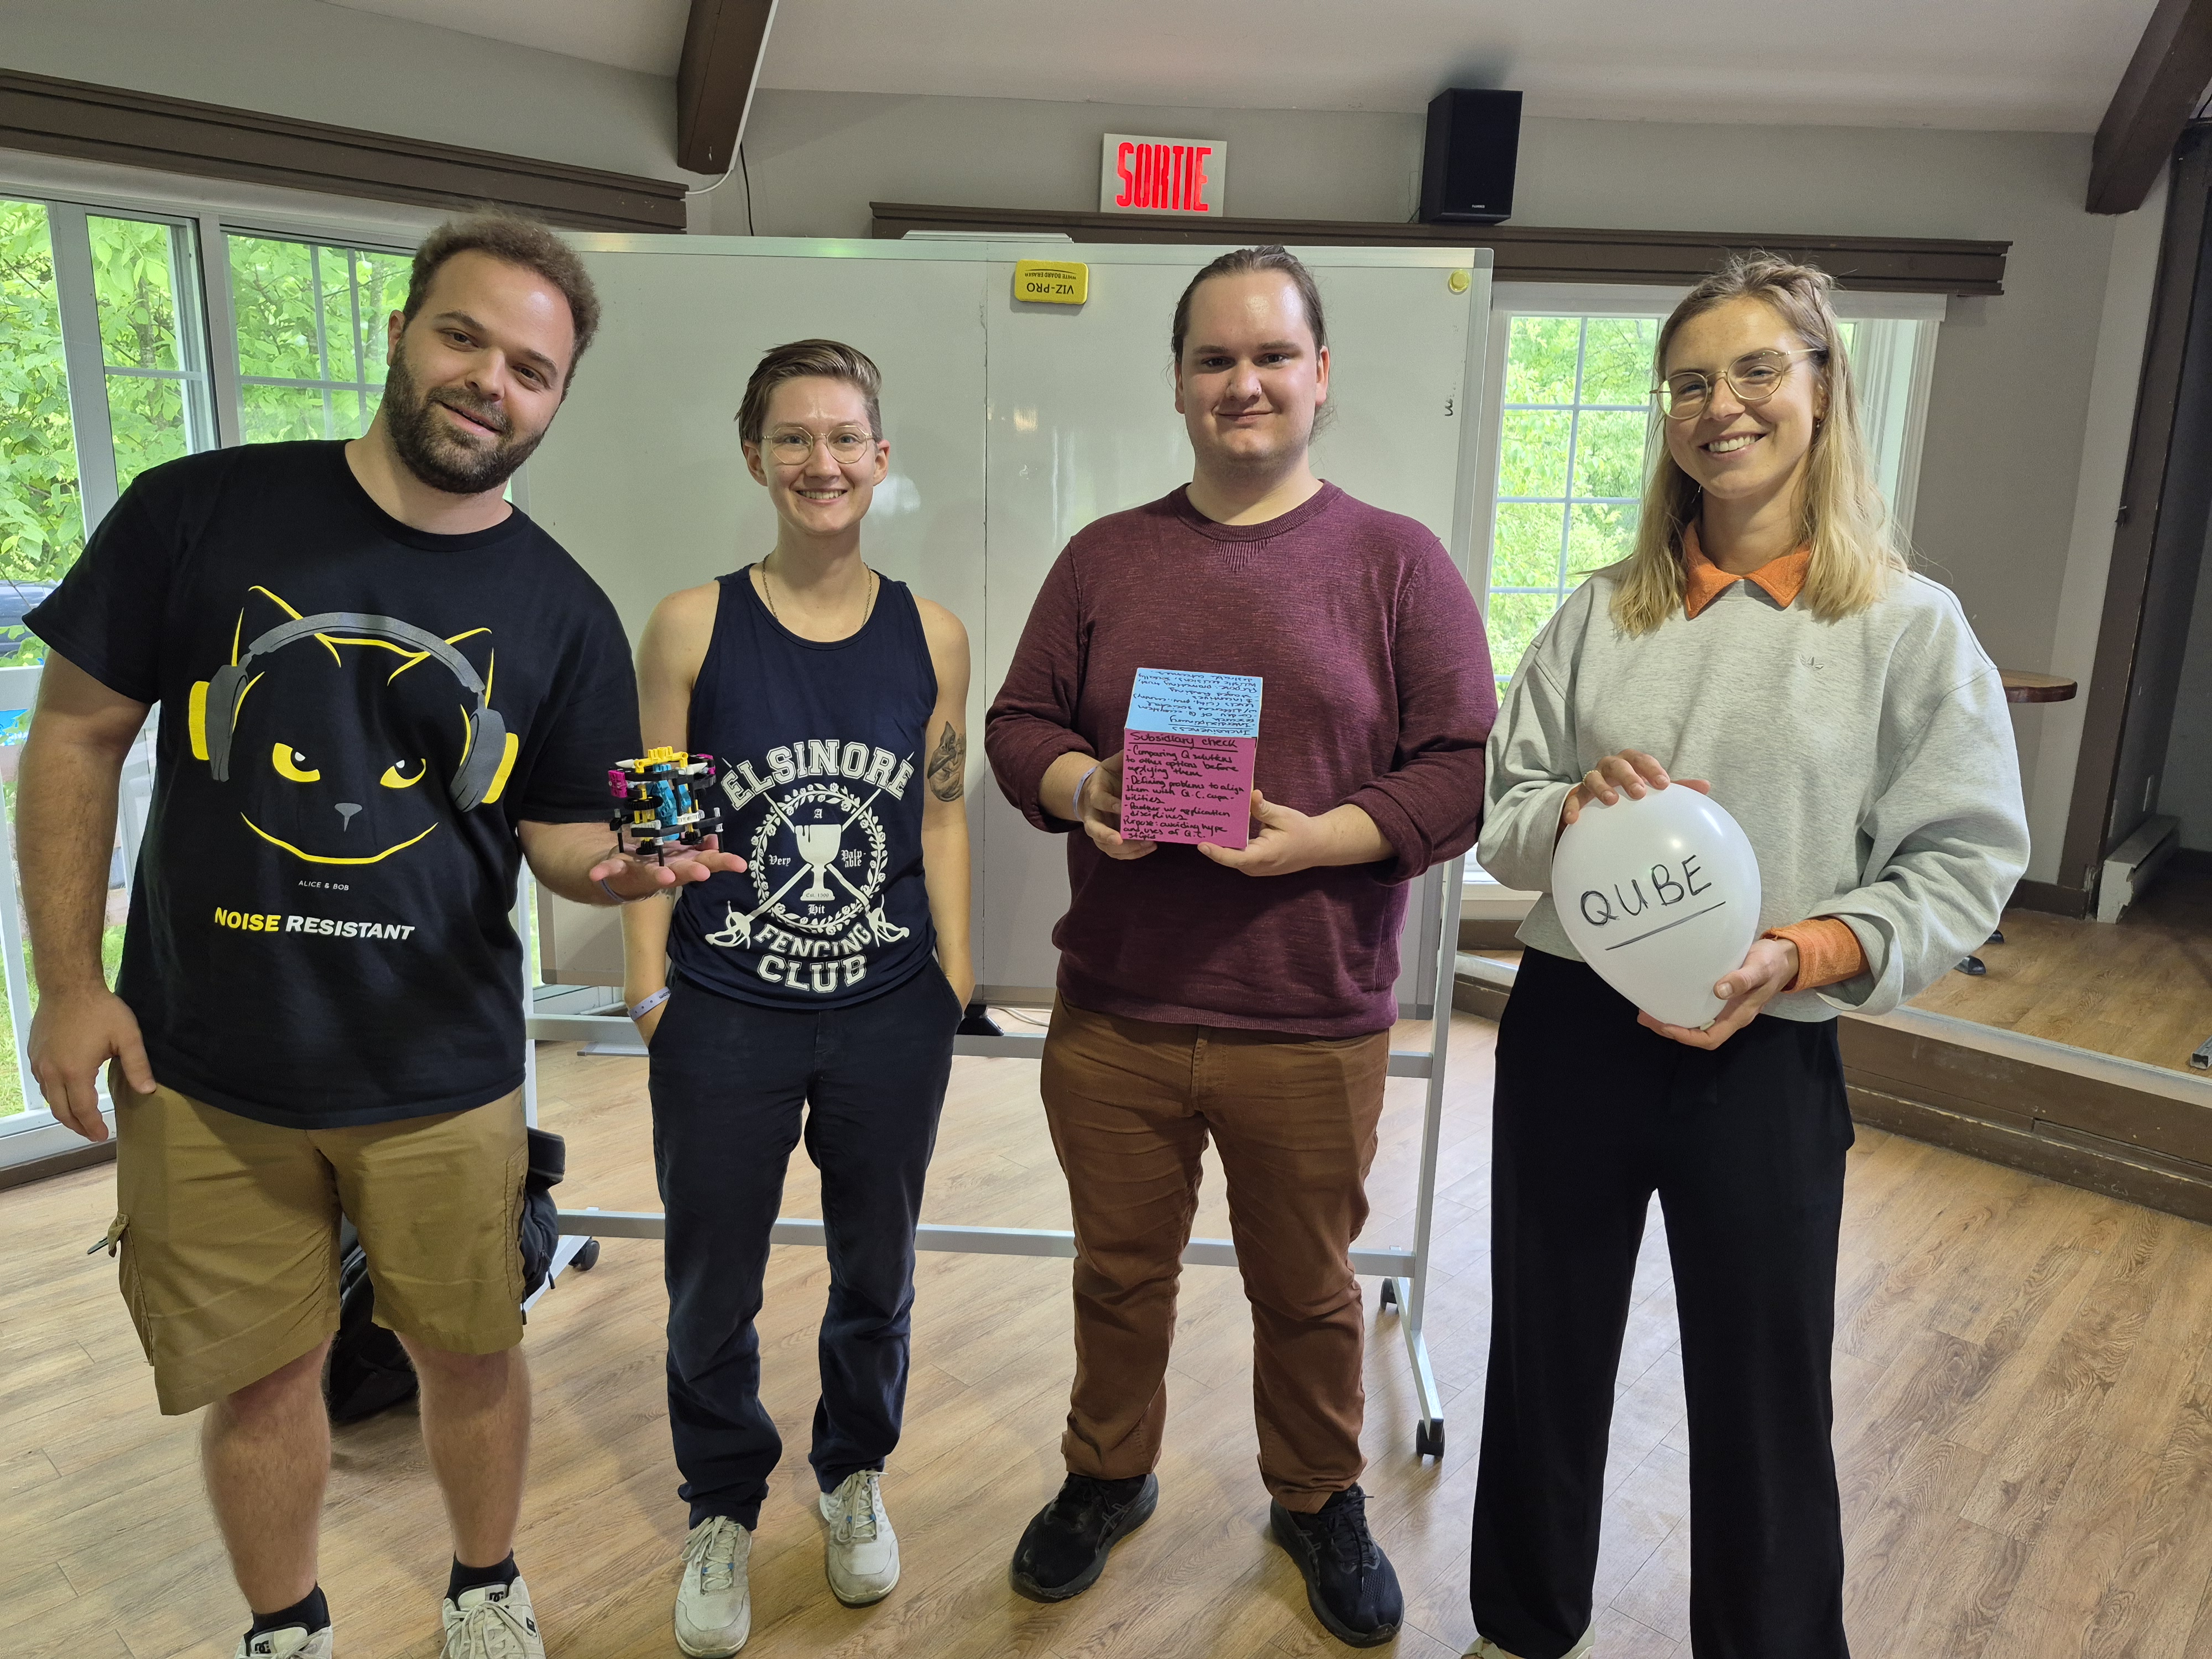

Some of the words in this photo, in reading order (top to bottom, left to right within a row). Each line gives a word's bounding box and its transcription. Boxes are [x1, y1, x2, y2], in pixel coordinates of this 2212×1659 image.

[1115, 142, 1212, 211] SORTIE
[1026, 283, 1074, 294] VIZ-PRO
[1130, 732, 1194, 749] Subsidiary
[1202, 738, 1238, 748] check
[1133, 744, 1177, 761] Comparing
[1181, 750, 1190, 759] Q
[1128, 765, 1168, 779] applying
[1173, 768, 1203, 777] them
[1166, 760, 1197, 769] options
[1203, 761, 1239, 772] before
[721, 739, 915, 811] ELSINORE
[1131, 775, 1166, 788] Defining
[1169, 780, 1205, 790] problems
[1220, 783, 1244, 795] align
[1125, 793, 1165, 804] bilities
[813, 808, 823, 819] A
[1130, 810, 1187, 820] disciplines
[1180, 806, 1230, 817] application
[1160, 821, 1199, 832] avoiding
[1202, 823, 1228, 837] hype
[769, 854, 791, 867] Very
[844, 857, 862, 868] able
[298, 880, 321, 889] ALICE
[1580, 854, 1712, 927] QUBE
[807, 904, 826, 915] Hit
[215, 906, 281, 932] NOISE
[285, 915, 415, 940] RESISTANT
[753, 922, 872, 959] FENCING
[757, 953, 868, 993] CLUB
